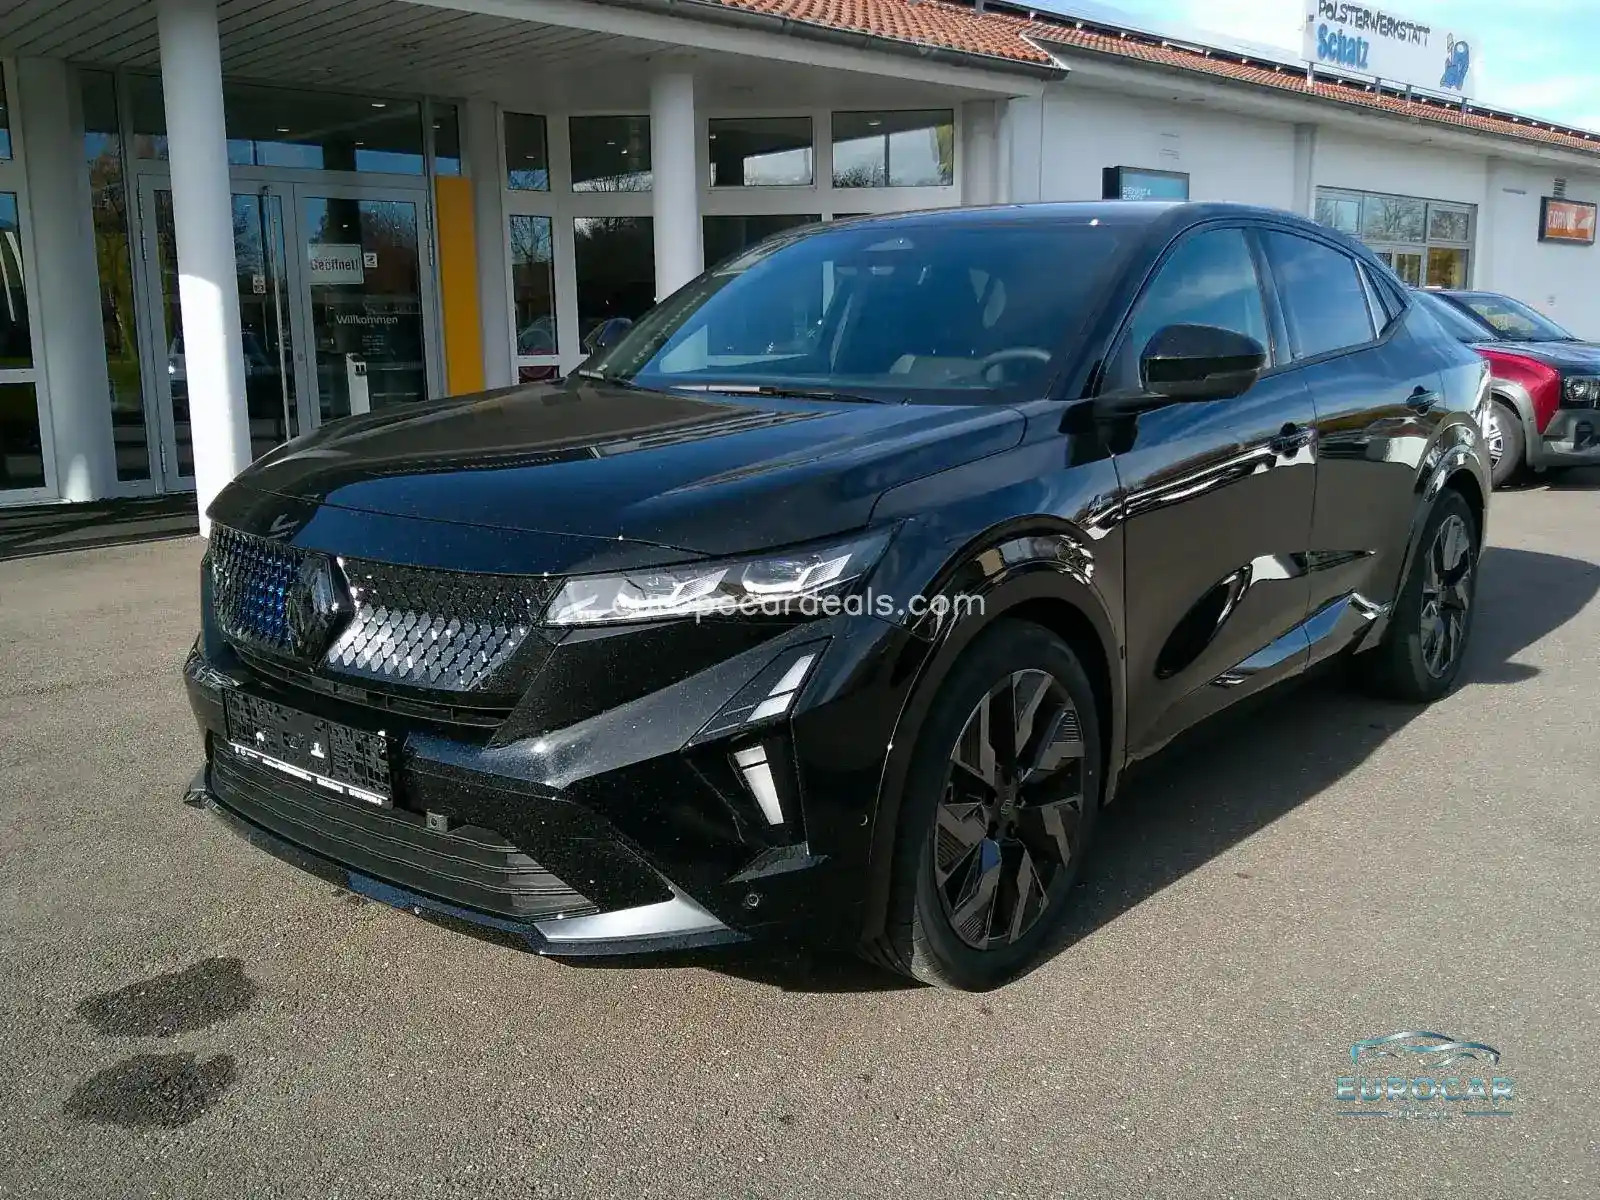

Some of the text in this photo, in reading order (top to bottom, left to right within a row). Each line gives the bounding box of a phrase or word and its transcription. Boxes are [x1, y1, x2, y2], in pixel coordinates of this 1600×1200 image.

[1317, 23, 1370, 70] Schatz
[1318, 0, 1431, 47] POLSTERWERKSTATT
[336, 314, 398, 324] Willkommen
